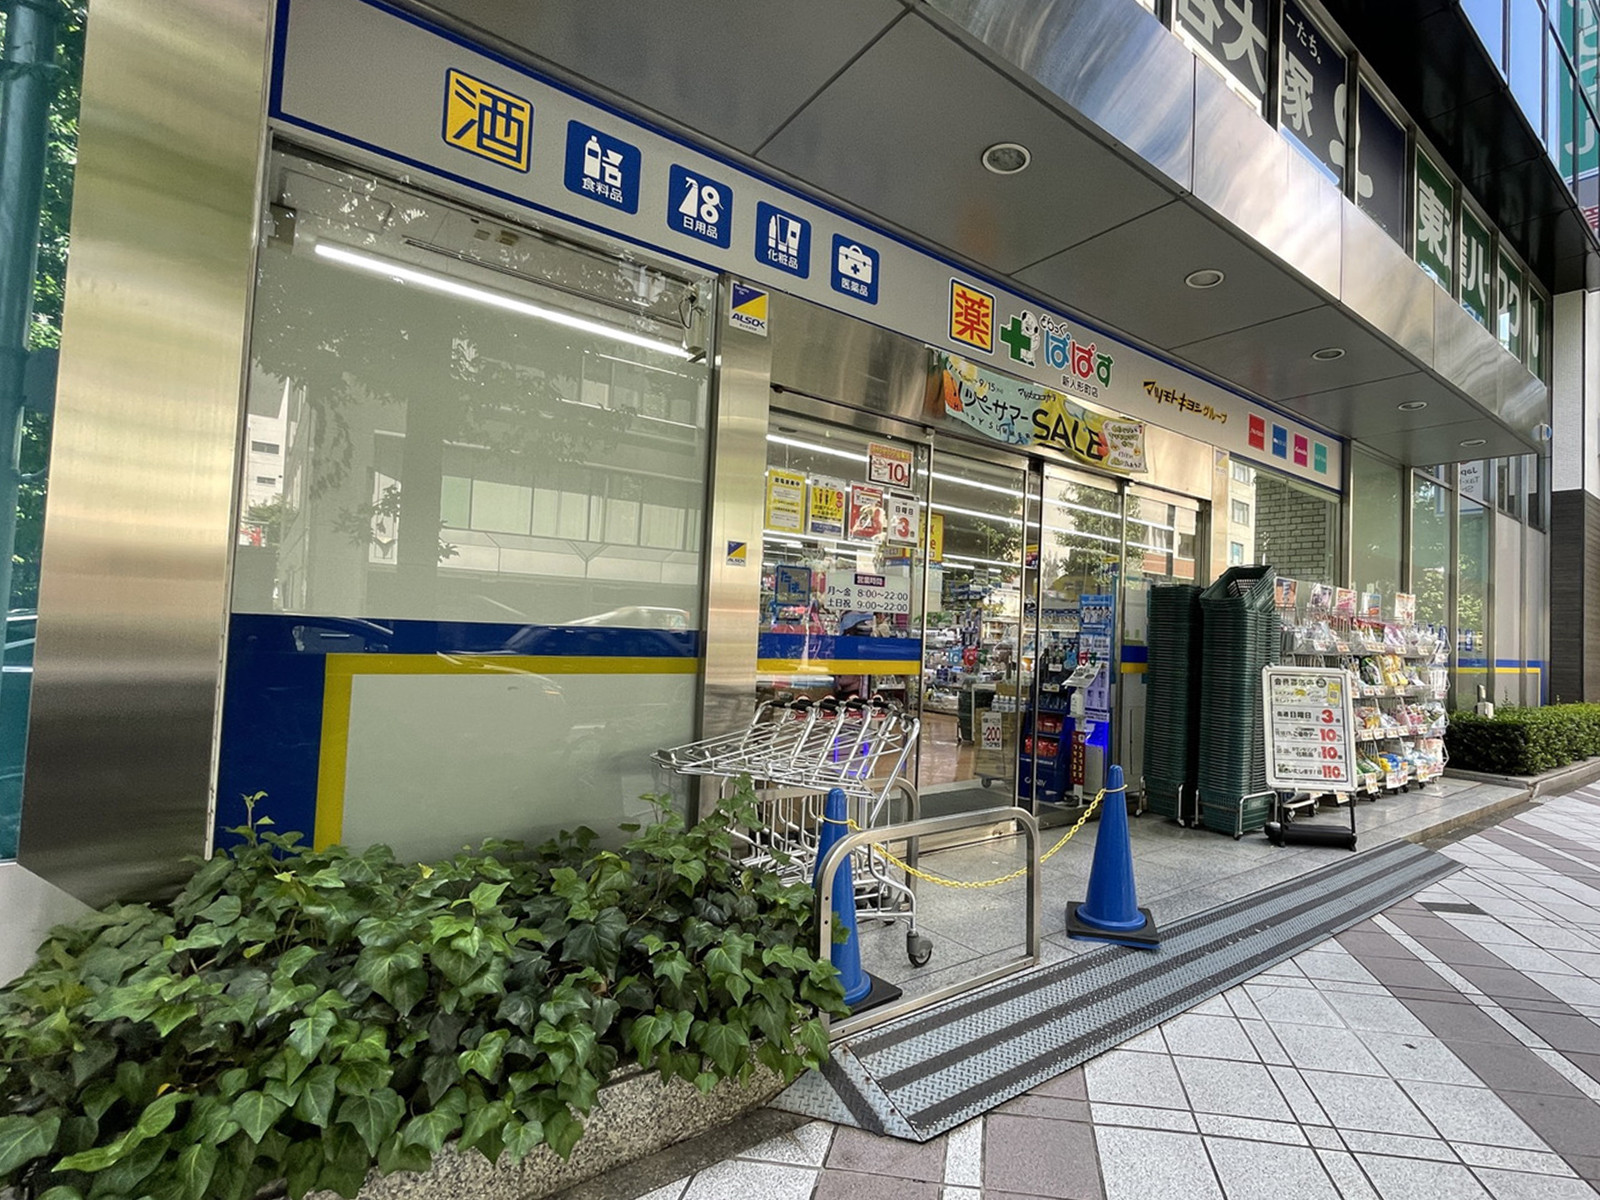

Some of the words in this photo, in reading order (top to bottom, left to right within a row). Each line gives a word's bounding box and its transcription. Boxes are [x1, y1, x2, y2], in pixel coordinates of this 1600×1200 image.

[453, 78, 525, 164] 酒
[582, 177, 623, 203] 食料品
[683, 215, 718, 240] 日用品
[767, 249, 799, 270] 化粧品
[841, 277, 869, 297] 医薬品
[732, 312, 766, 329] ALSOK
[955, 290, 989, 346] 薬
[1045, 330, 1114, 388] ぱぱす
[1062, 375, 1099, 398] 新人形町店
[1032, 408, 1103, 462] SALE
[896, 517, 910, 538] 3
[828, 598, 852, 608] 土日祝
[1321, 709, 1334, 724] 3
